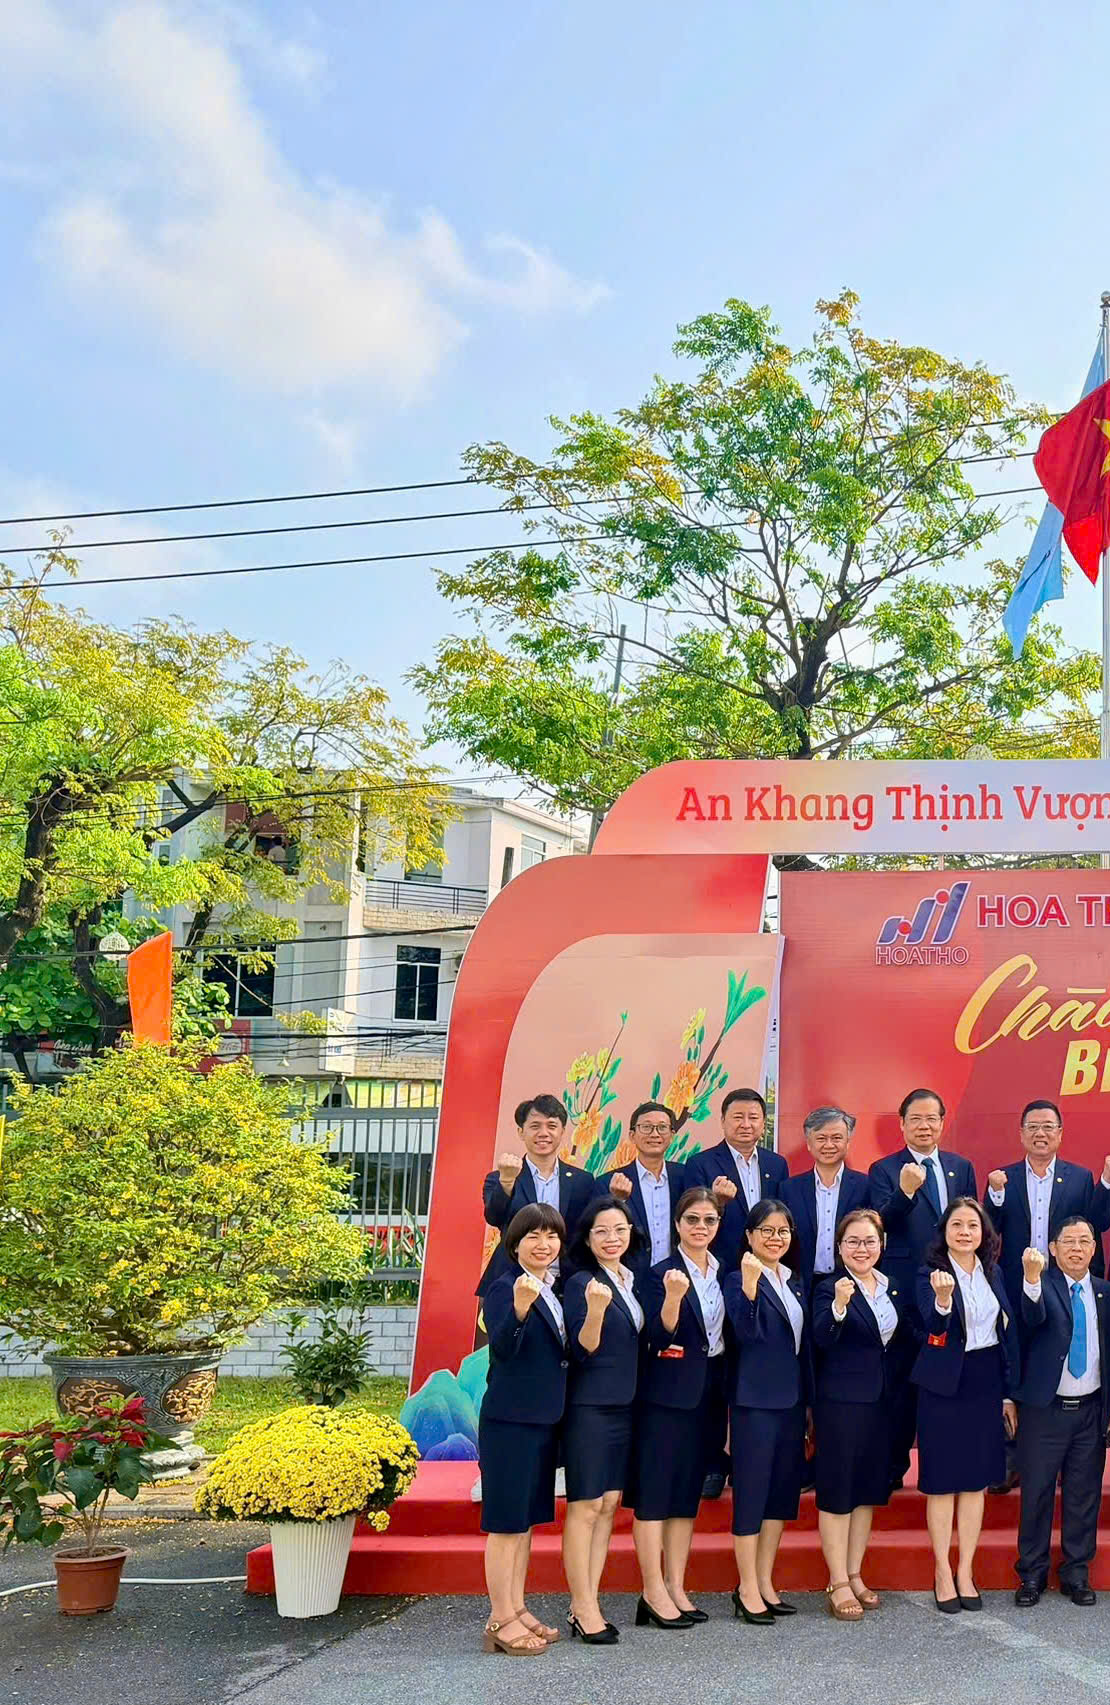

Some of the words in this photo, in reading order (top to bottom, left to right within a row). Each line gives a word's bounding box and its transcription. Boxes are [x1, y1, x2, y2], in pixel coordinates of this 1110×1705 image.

[676, 787, 732, 821] An
[744, 784, 874, 831] Khang
[885, 784, 1003, 832] Thịnh
[977, 894, 1070, 928] HOA
[875, 946, 969, 966] HOATHO
